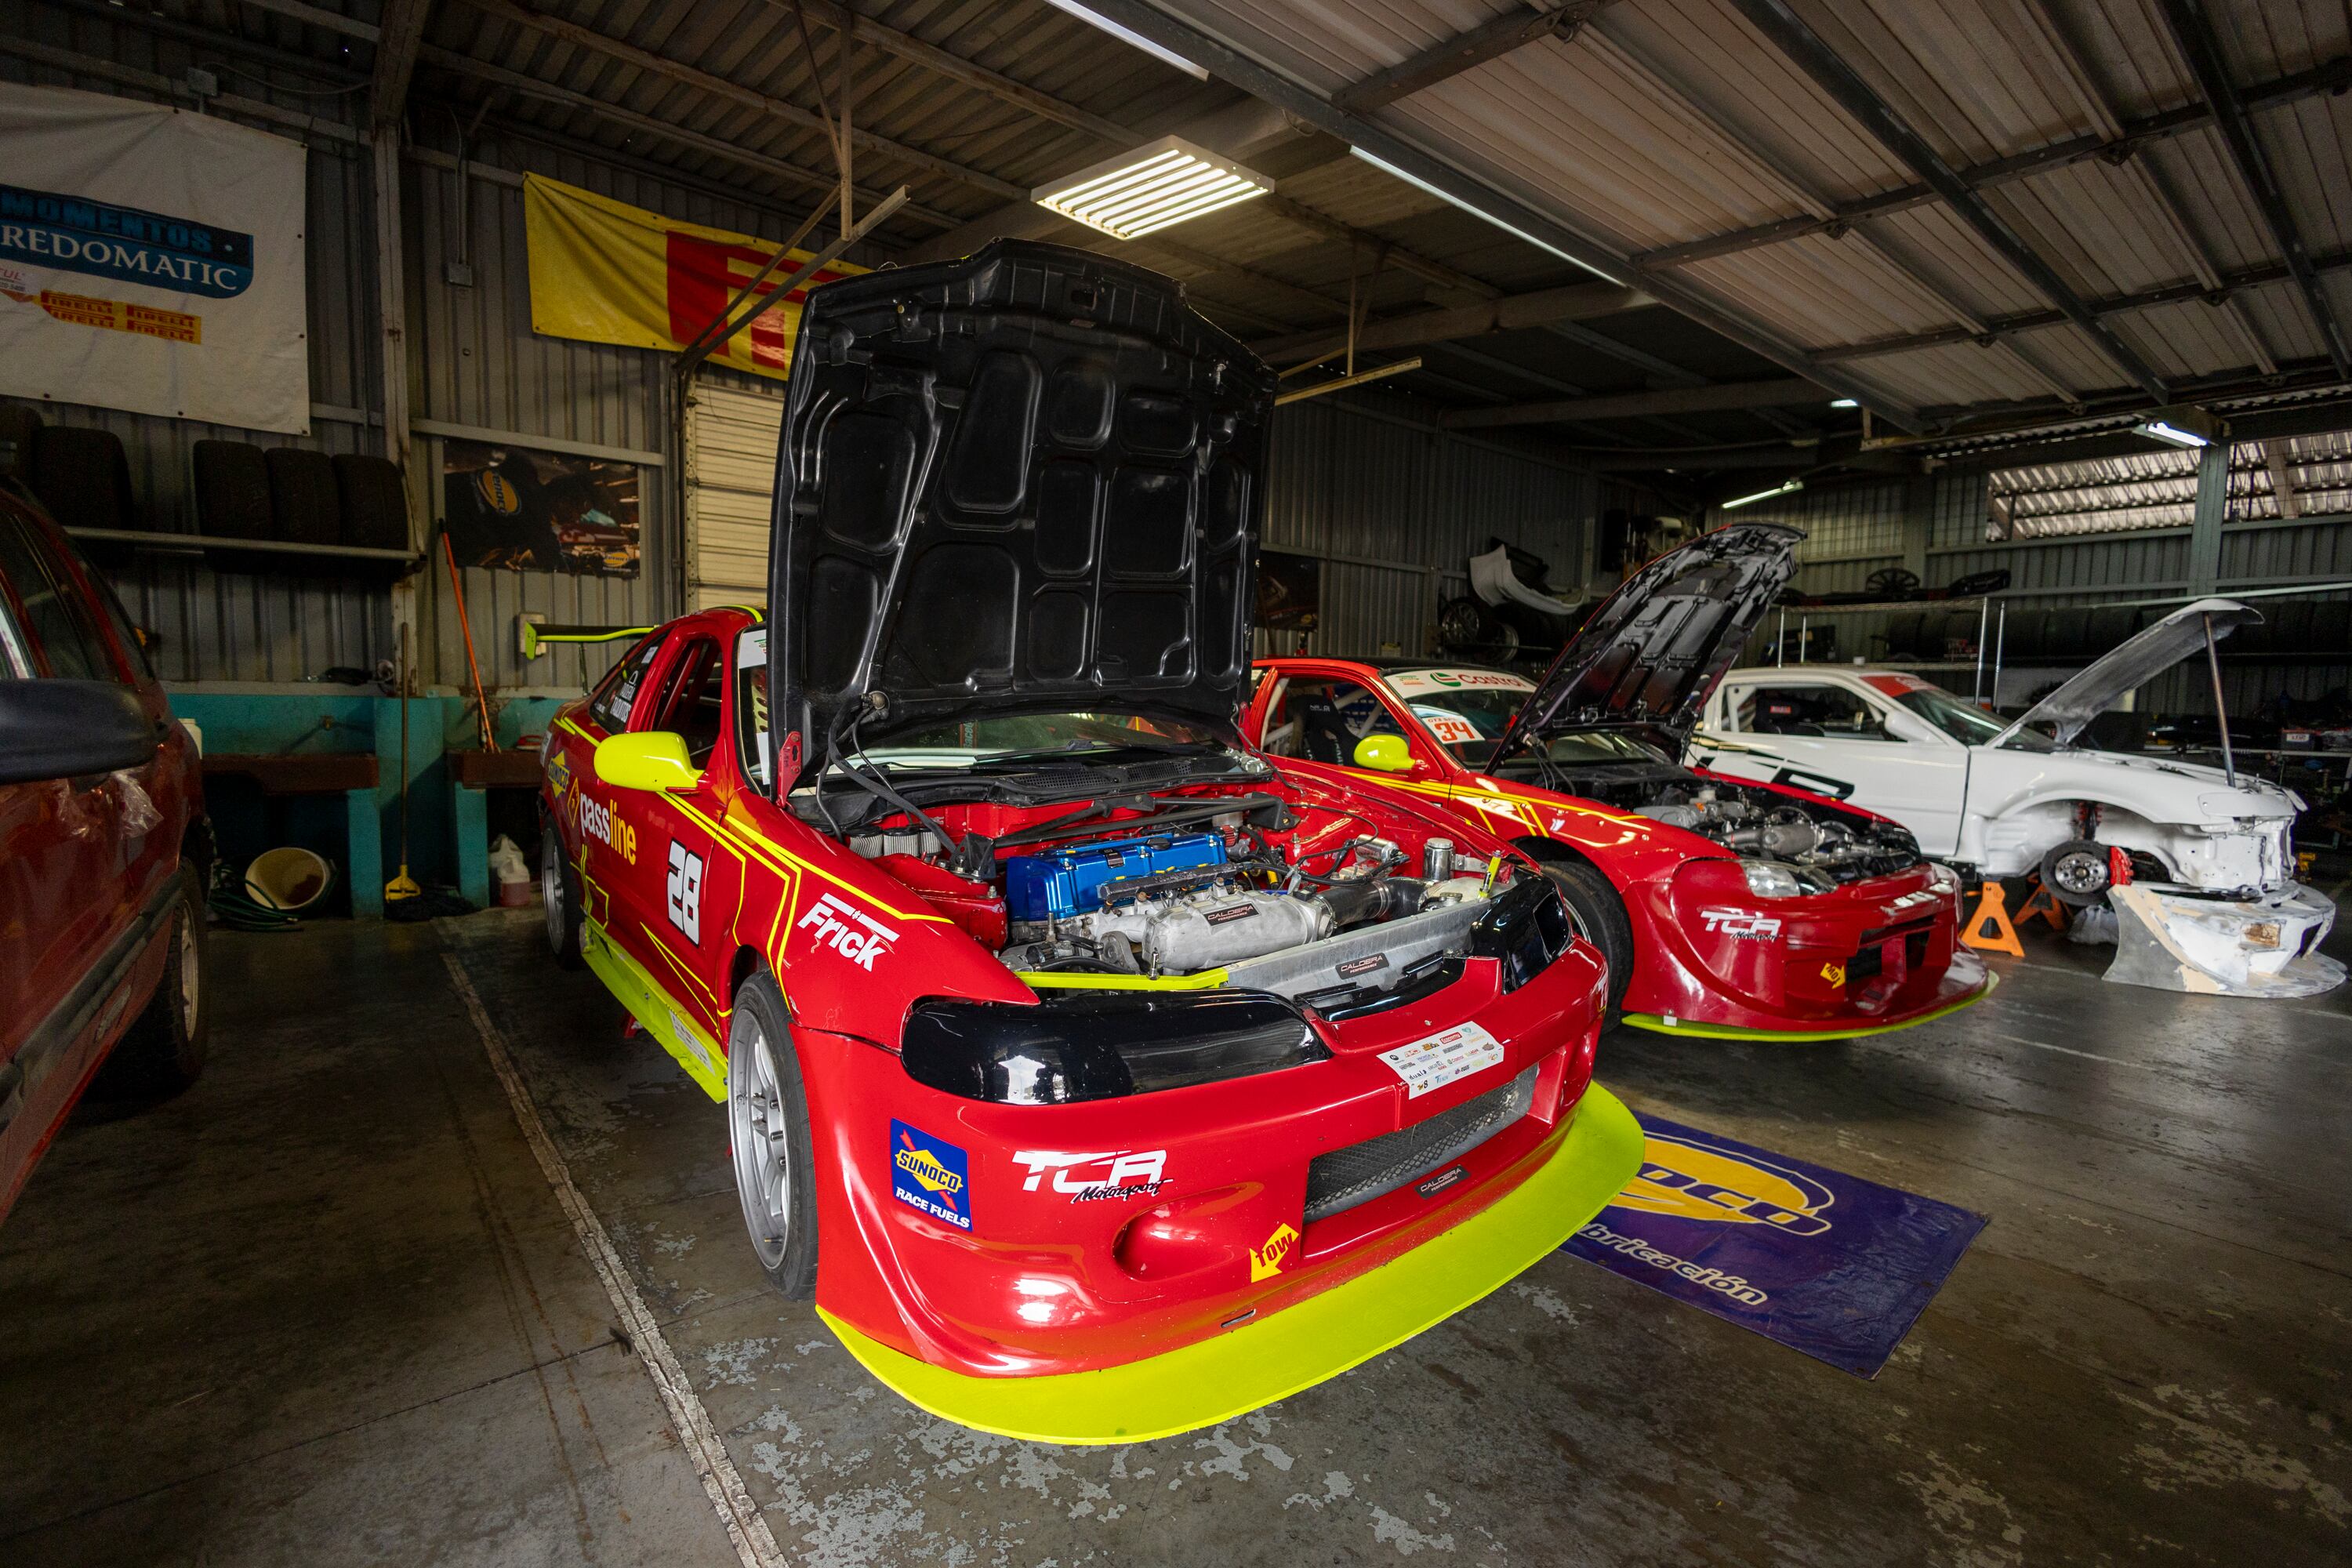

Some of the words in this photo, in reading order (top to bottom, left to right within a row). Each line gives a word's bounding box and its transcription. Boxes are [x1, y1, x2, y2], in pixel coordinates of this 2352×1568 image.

[1, 192, 212, 252] MOMENTOS
[0, 225, 238, 290] REDOMATIC
[127, 304, 195, 328] PIRELLI
[127, 319, 195, 342] PIRELLI
[1457, 673, 1526, 688] Castrol
[1433, 721, 1475, 742] 34
[580, 792, 637, 866] passline
[667, 838, 703, 947] 28
[1207, 905, 1254, 920] CALDERA
[1340, 954, 1384, 973] CALDERA
[898, 1152, 959, 1190] SUNOCO
[1012, 1149, 1167, 1193] TCR
[1420, 1167, 1462, 1192] CALDERA
[896, 1185, 929, 1210] RACE
[930, 1203, 970, 1229] FUELS
[1070, 1178, 1174, 1204] Motorsport
[1255, 1232, 1293, 1268] TOW
[1576, 1223, 1769, 1305] bricación
